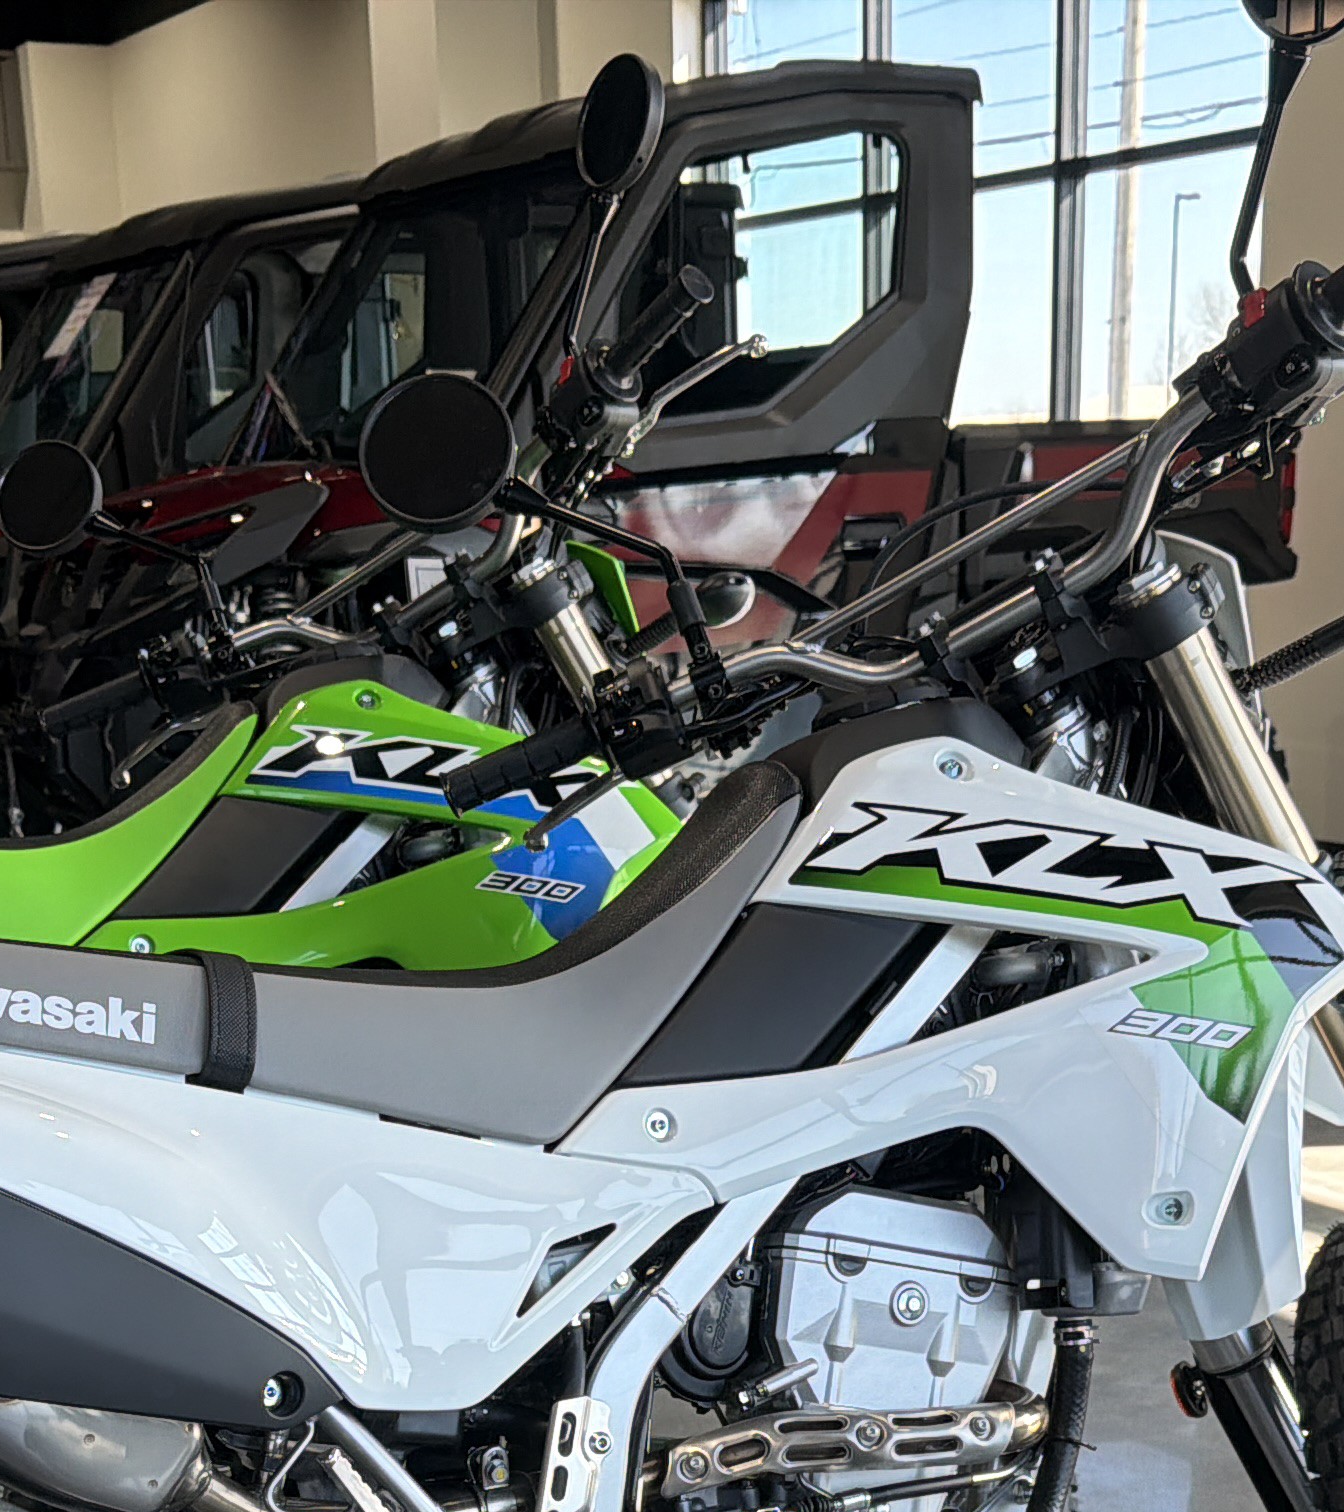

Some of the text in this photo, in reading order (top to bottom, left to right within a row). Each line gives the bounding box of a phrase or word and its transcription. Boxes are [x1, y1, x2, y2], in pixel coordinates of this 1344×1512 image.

[804, 801, 1322, 928] KLX
[477, 871, 584, 902] 300
[1108, 1007, 1254, 1049] 300
